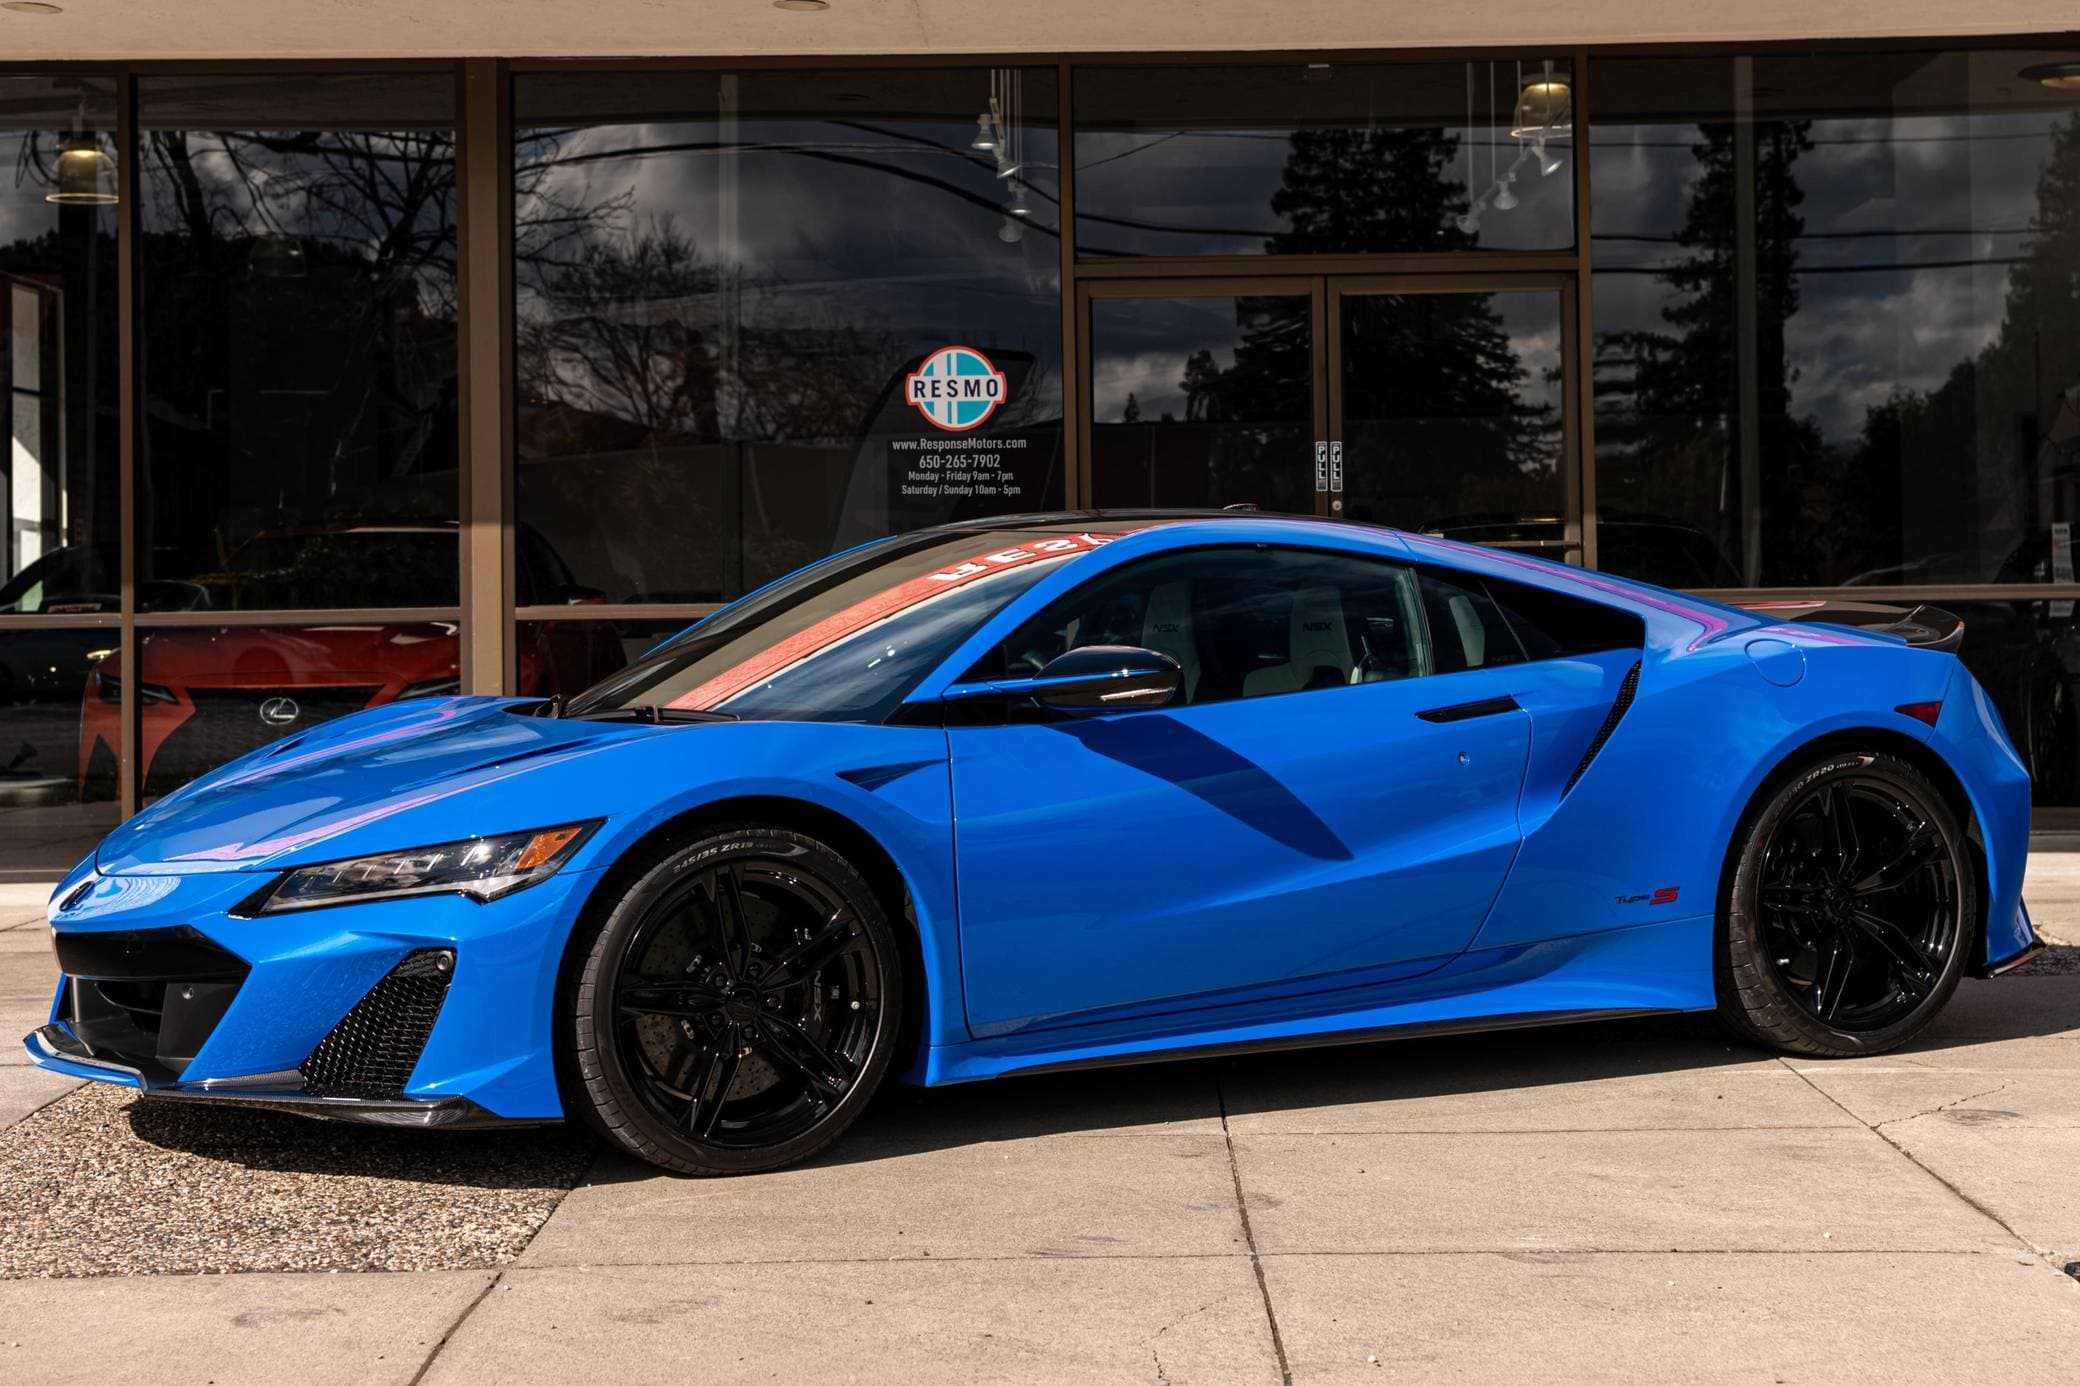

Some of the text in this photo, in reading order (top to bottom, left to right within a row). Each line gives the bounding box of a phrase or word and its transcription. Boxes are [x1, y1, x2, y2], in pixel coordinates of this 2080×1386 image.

[913, 378, 999, 398] RESMO
[892, 438, 1027, 452] www.ResponseMotors.com
[919, 454, 1001, 469] 650-265-7902
[1318, 446, 1326, 479] PULL
[1332, 446, 1340, 480] PULL
[908, 471, 939, 483] Monday
[946, 471, 972, 483] Friday
[973, 471, 990, 481] 9am
[997, 471, 1014, 482] 7pm
[902, 485, 938, 497] Saturday
[944, 485, 973, 497] Sunday
[974, 485, 996, 495] 10am
[1003, 485, 1021, 496] 5pm
